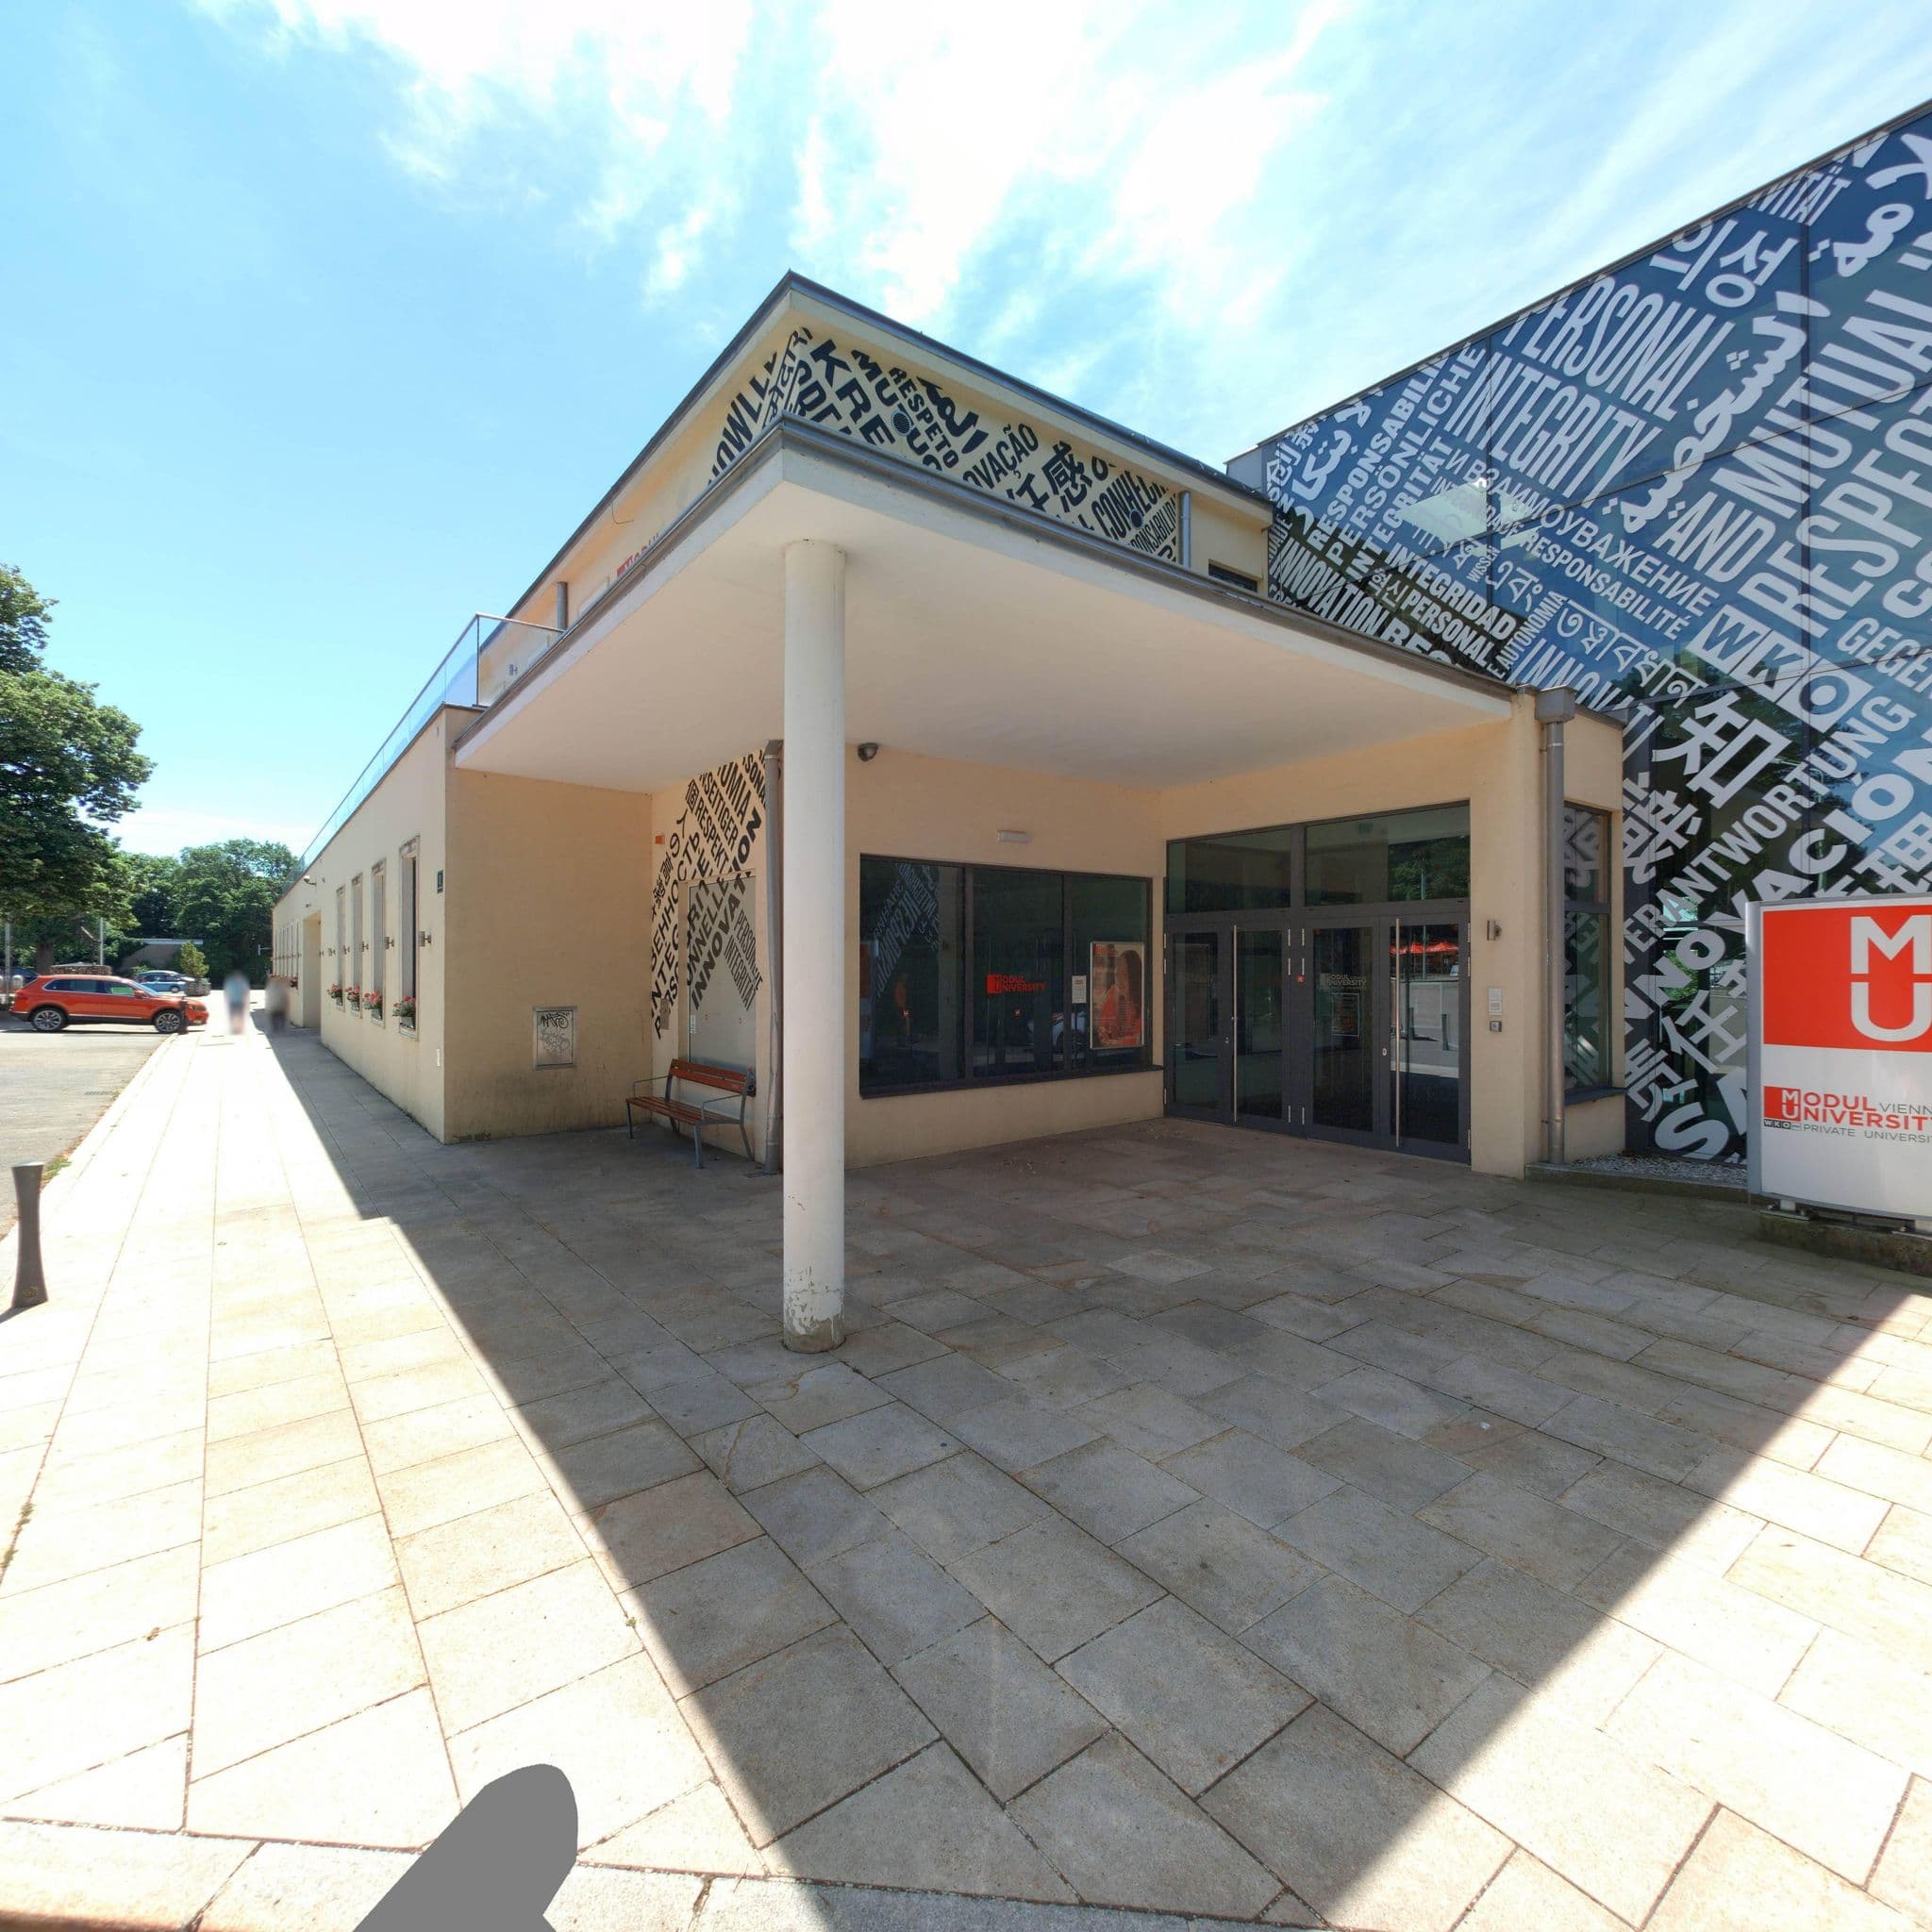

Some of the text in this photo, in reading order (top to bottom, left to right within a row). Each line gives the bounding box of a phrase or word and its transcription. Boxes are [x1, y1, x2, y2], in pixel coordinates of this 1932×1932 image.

[890, 367, 959, 469] RESPETO
[1443, 350, 1662, 509] INTEGRITY
[1346, 436, 1454, 582] INTEGRITÄT
[1652, 491, 1775, 582] AND
[1269, 537, 1391, 636] INNOVATION
[1385, 542, 1516, 641] INTEGRIDAD
[1520, 529, 1690, 640] RESPONSABILITÉ
[1400, 589, 1495, 667] PERSONAL
[1498, 591, 1567, 671] AUTONOMIA
[695, 797, 729, 874] RESPEKT
[1764, 1119, 1791, 1129] WKO
[1781, 1090, 1877, 1111] MODUL
[1781, 1105, 1932, 1131] UNIVERSIT
[1803, 1124, 1932, 1143] PRIVATE UNIVERSI
